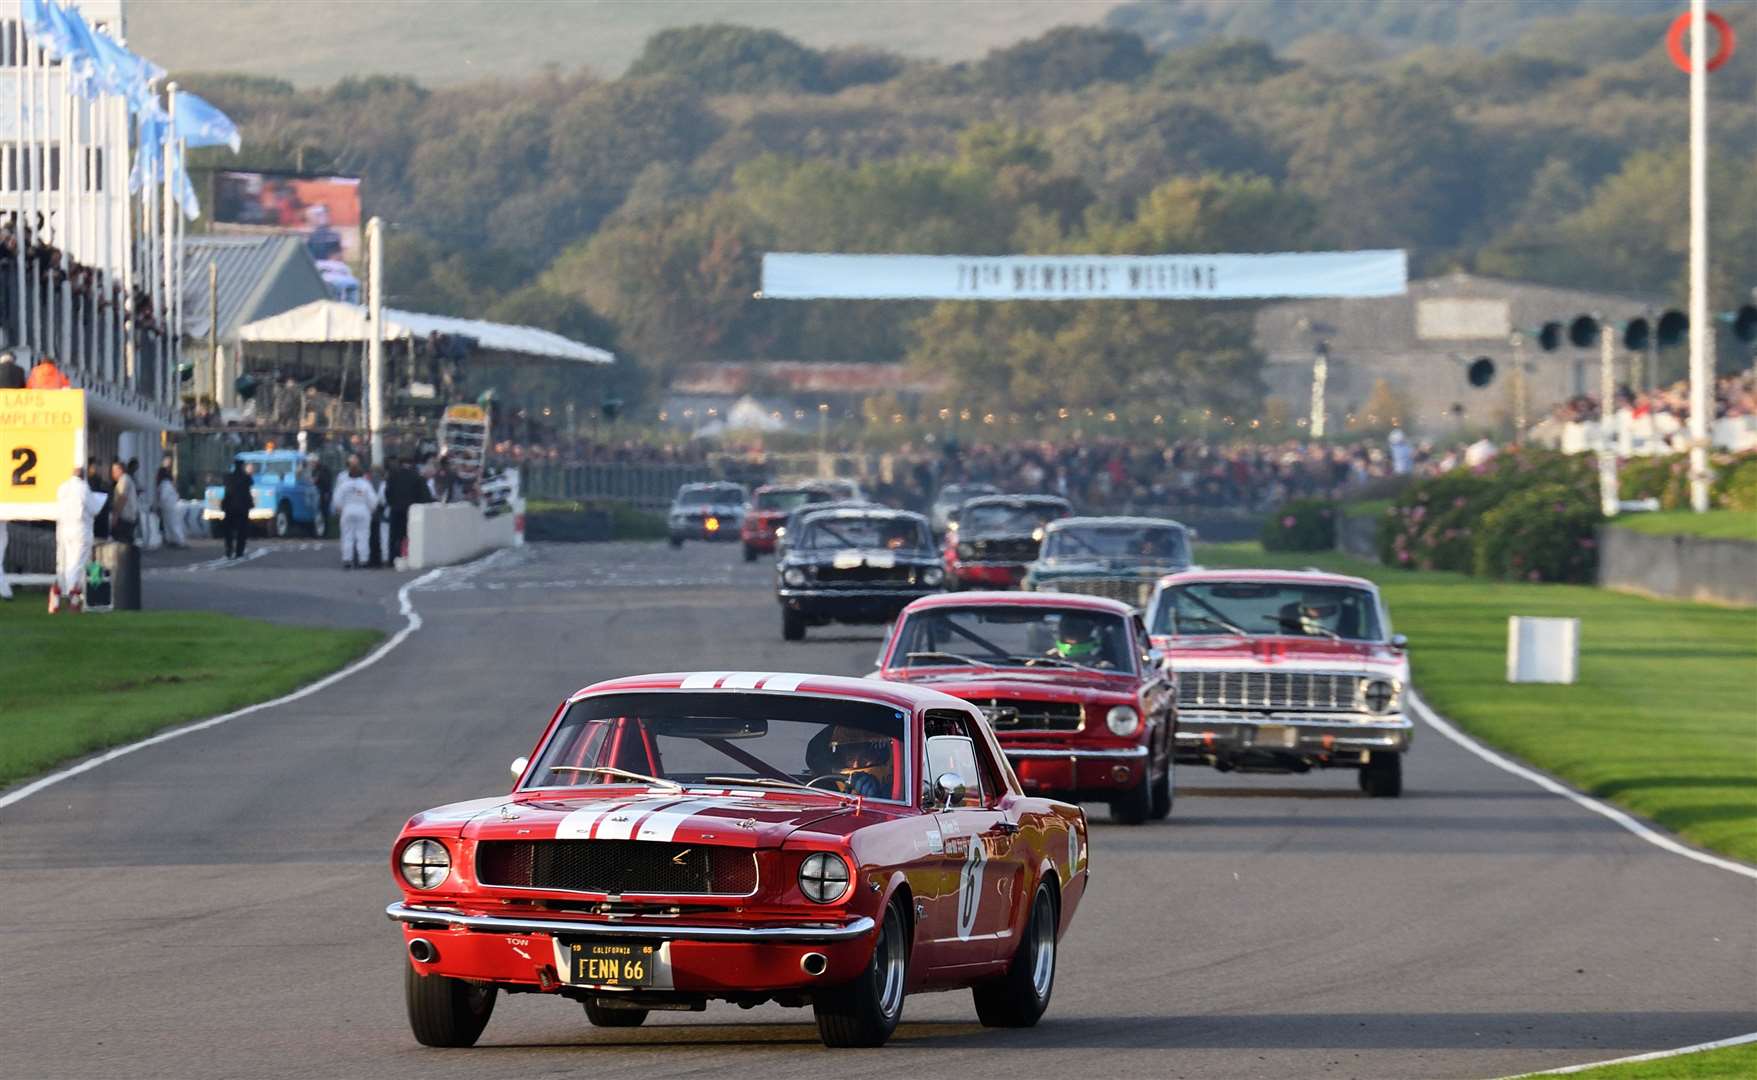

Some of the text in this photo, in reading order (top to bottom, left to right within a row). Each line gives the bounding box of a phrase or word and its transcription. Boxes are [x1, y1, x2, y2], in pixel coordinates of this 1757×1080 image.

[1128, 264, 1217, 291] MEETING
[5, 393, 45, 407] LAPS
[12, 448, 37, 485] 2
[505, 938, 529, 946] TOW
[593, 946, 631, 954] CALIFORNIA
[624, 961, 644, 979] 66
